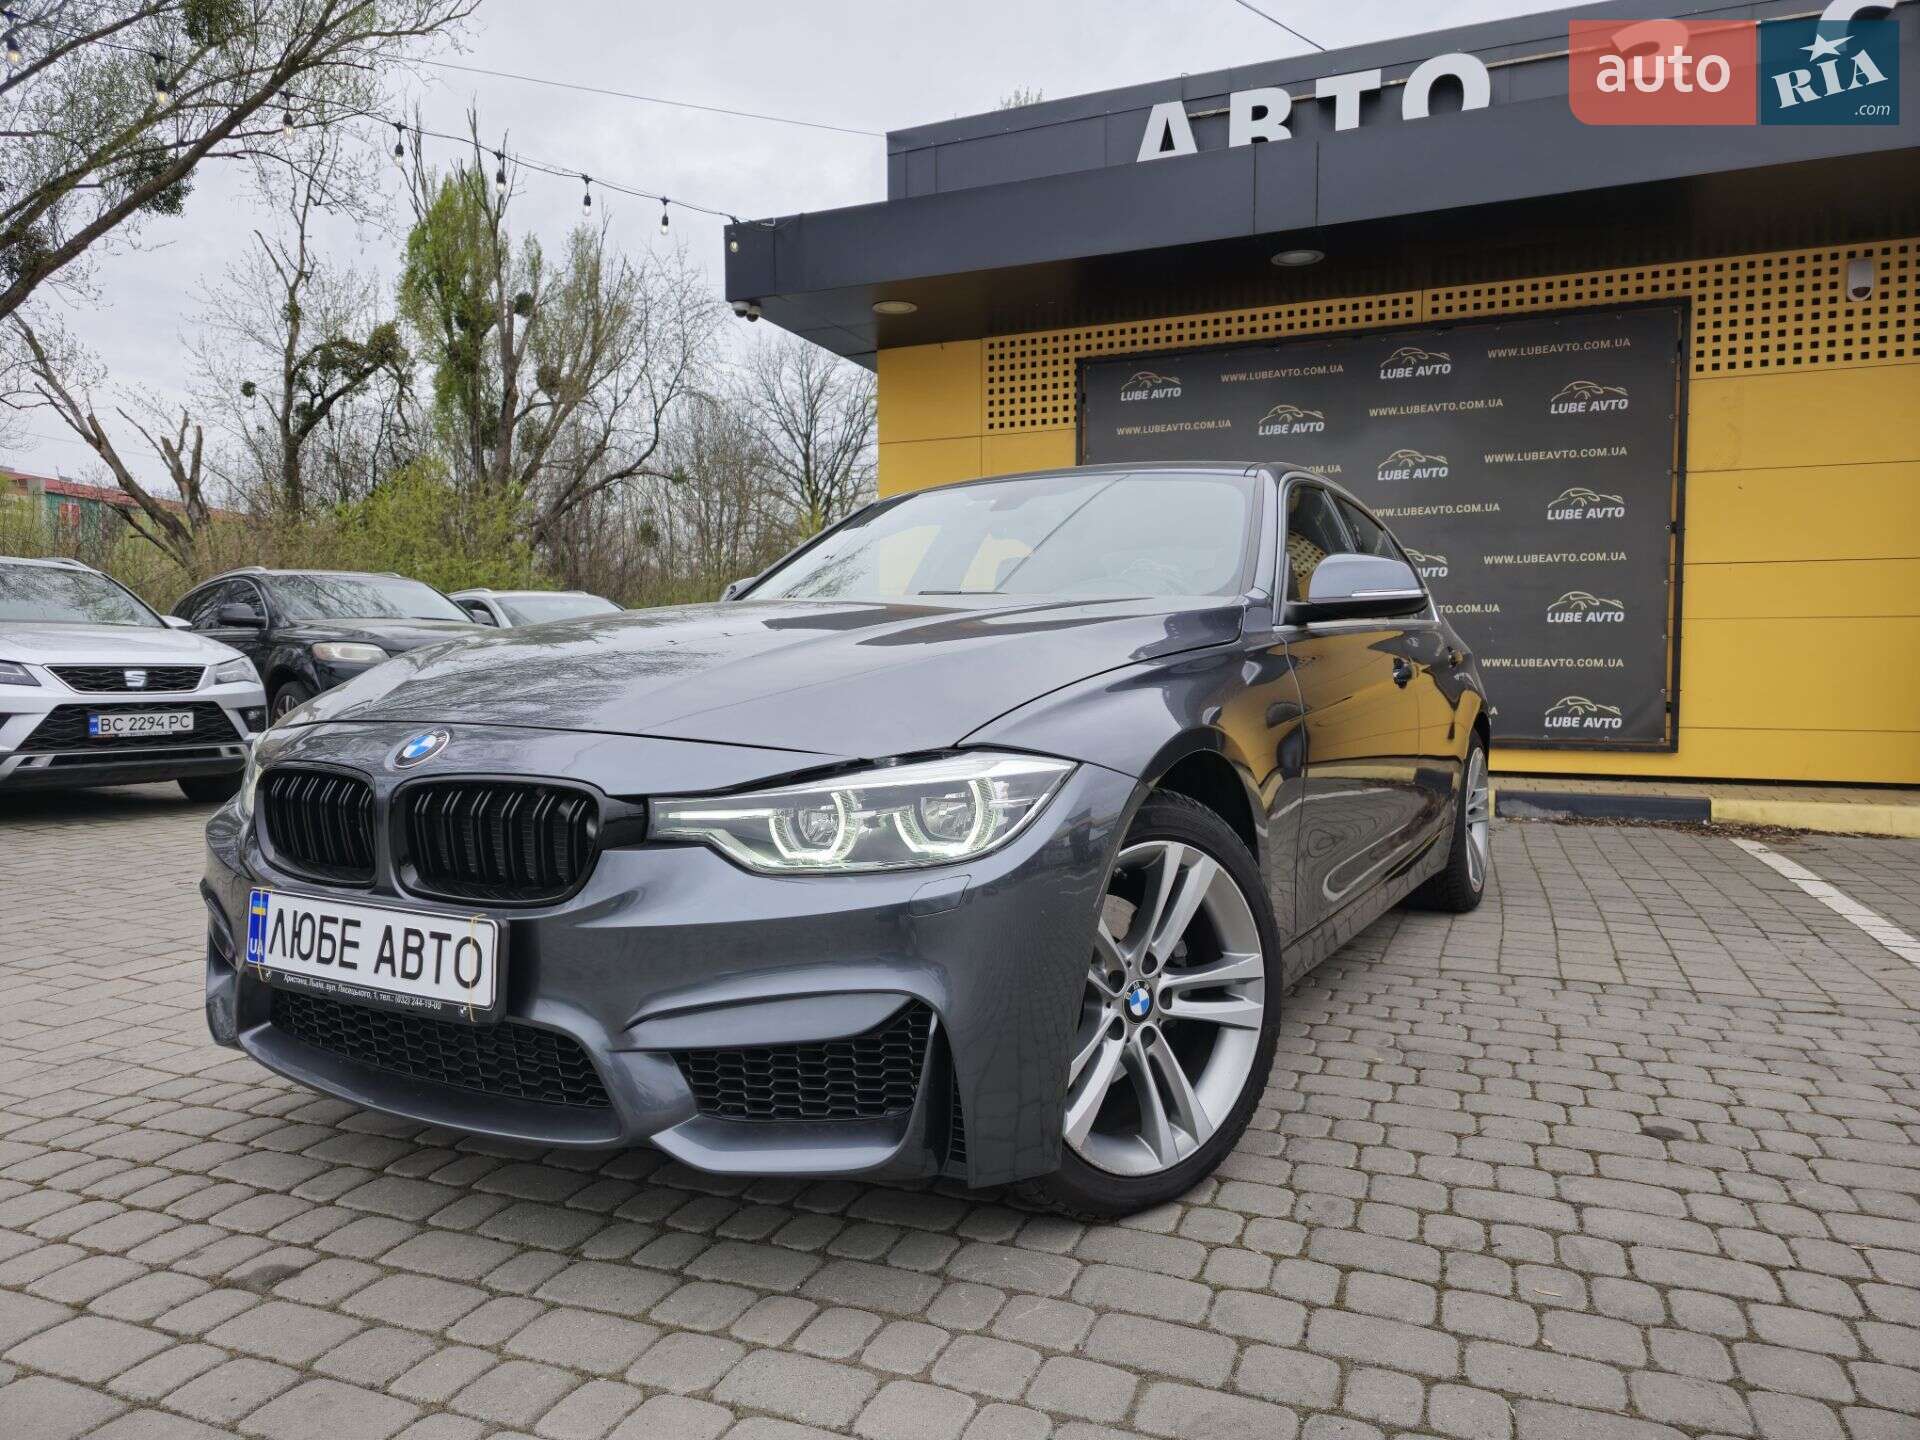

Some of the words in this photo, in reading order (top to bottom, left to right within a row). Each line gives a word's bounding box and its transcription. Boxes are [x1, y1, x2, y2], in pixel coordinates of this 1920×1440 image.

[1487, 338, 1632, 359] WWW.LUBEAVTO.COM.UA
[1221, 365, 1344, 383] WWW.LUBEAVTO.COM.UA
[1380, 367, 1413, 379] LUBE
[1415, 363, 1451, 377] AVTO
[1121, 390, 1148, 402] LUBE
[1150, 387, 1182, 399] AVTO
[1369, 398, 1504, 417] WWW.LUBEAVTO.COM.UA
[1551, 401, 1586, 414] LUBE
[1589, 399, 1628, 412] AVTO
[1117, 419, 1232, 436] WWW.LUBEAVTO.COM.UA
[1258, 423, 1288, 436] LUBE
[1291, 421, 1325, 434] AVTO
[1484, 446, 1628, 464] WWW.LUBEAVTO.COM.UA
[1378, 468, 1411, 481] LUBE
[1413, 465, 1449, 479] AVTO
[1547, 506, 1582, 520] LUBE
[1586, 504, 1625, 519] AVTO
[1483, 551, 1627, 565] WWW.LUBEAVTO.COM.UA
[1547, 612, 1582, 623] LUBE
[1586, 611, 1625, 623] AVTO
[1481, 658, 1624, 668] WWW.LUBEAVTO.COM.UA
[129, 716, 164, 731] 2294
[1545, 716, 1581, 728] LUBE
[1583, 717, 1622, 729] AVTO
[268, 908, 361, 970] ЛЮБЕ
[373, 925, 483, 989] АВТО
